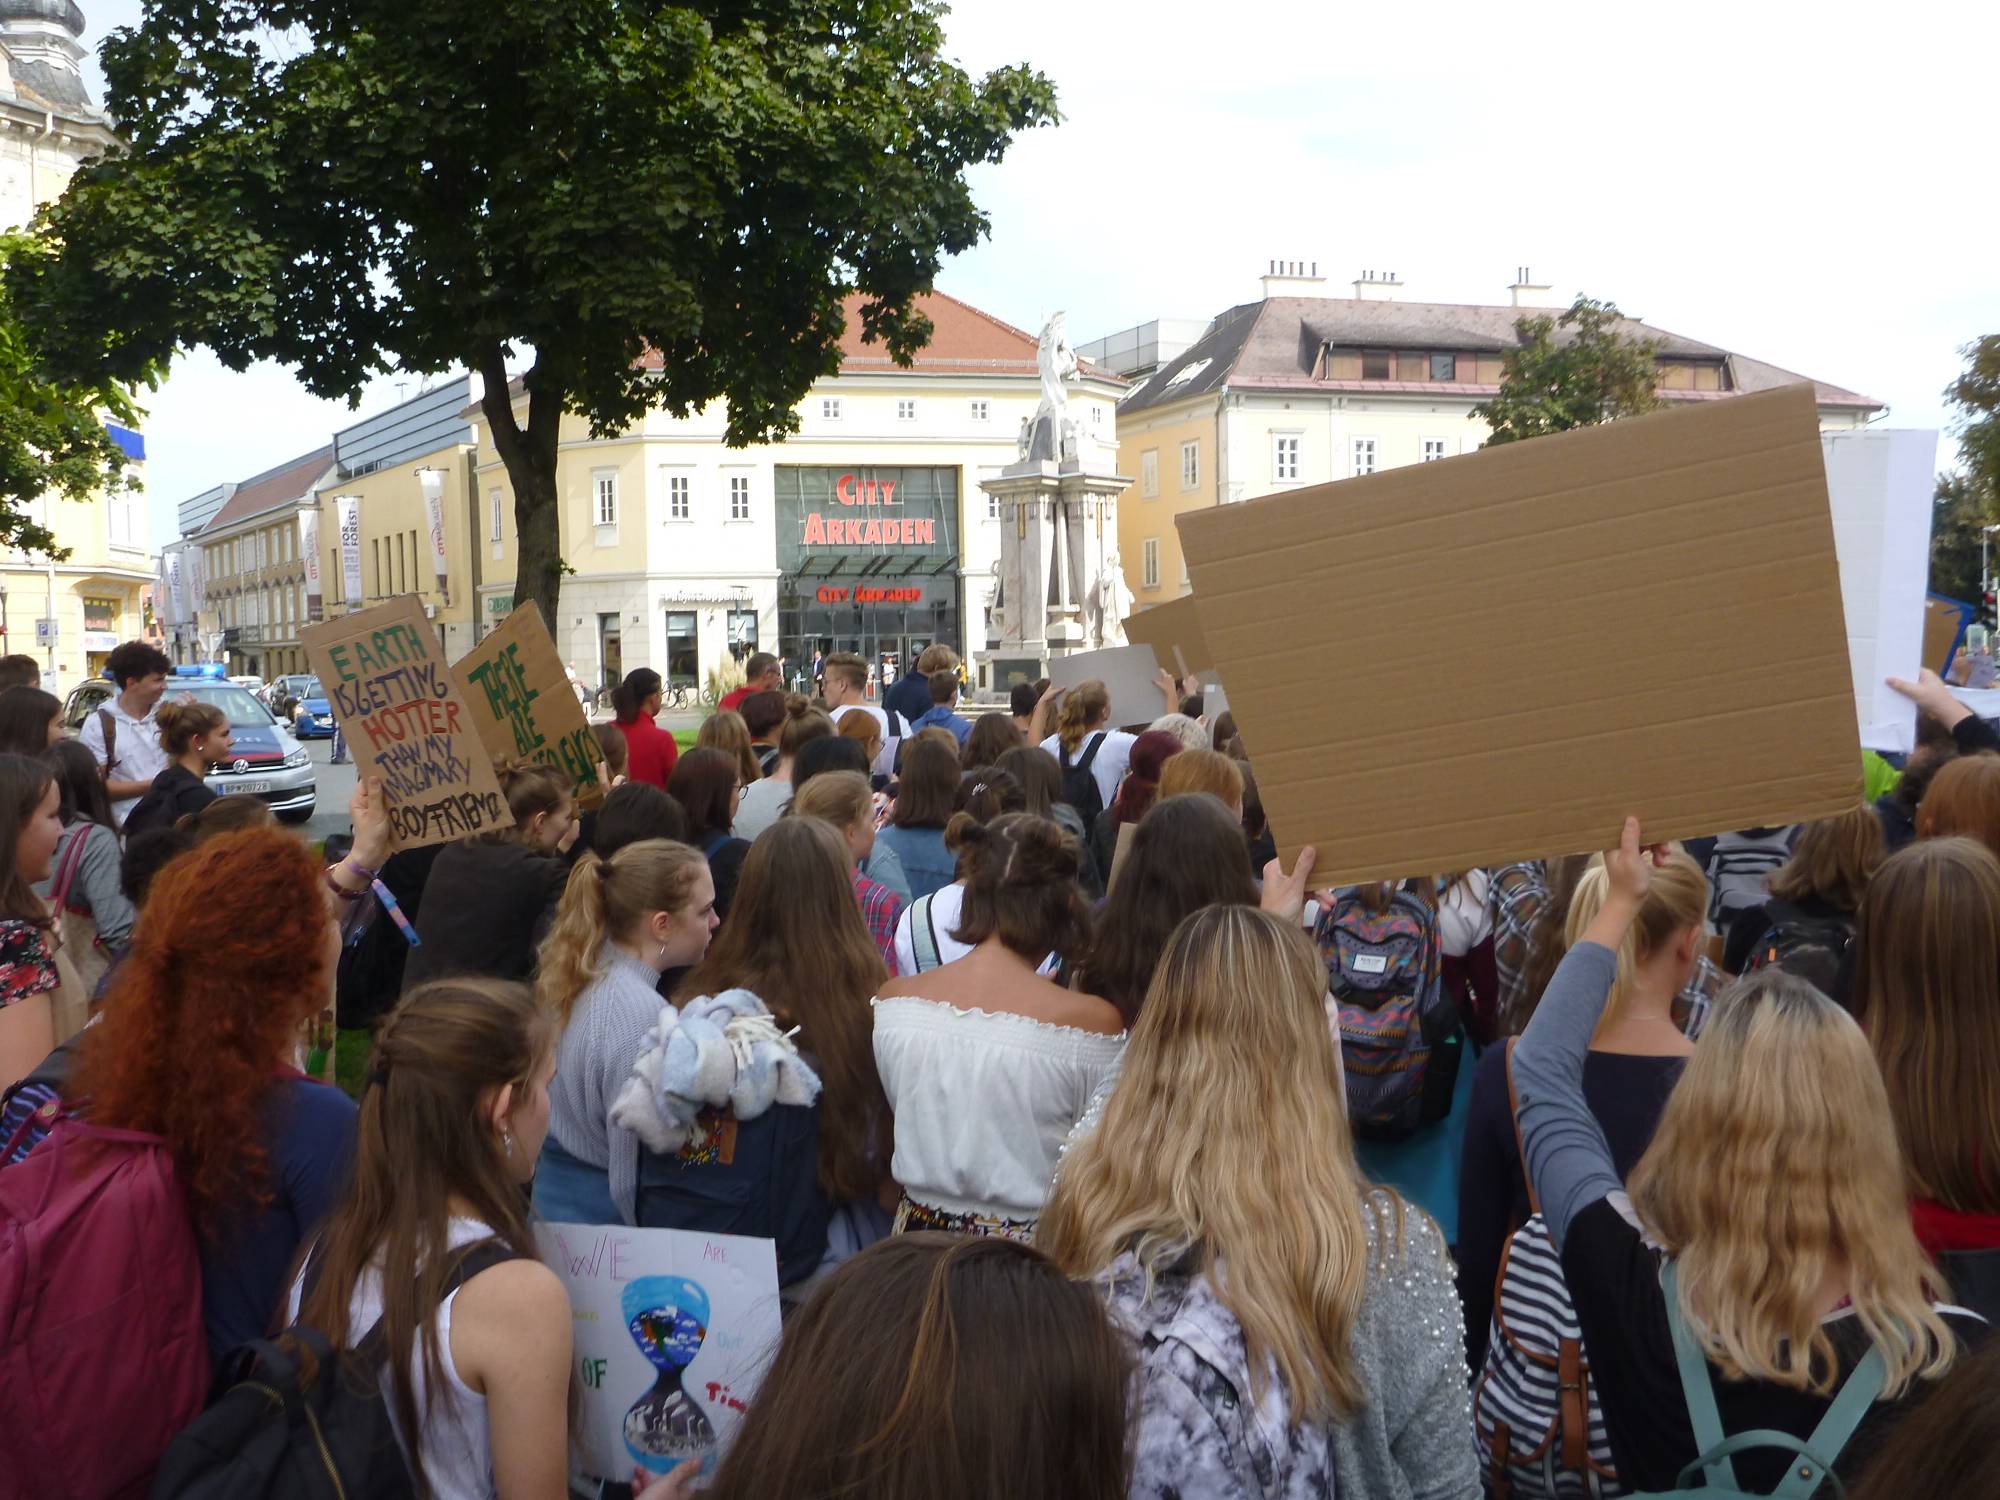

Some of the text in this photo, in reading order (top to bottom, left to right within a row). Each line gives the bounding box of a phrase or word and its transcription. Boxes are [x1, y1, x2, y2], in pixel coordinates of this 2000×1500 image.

[836, 473, 895, 506] CITY
[342, 526, 350, 546] FOR
[349, 510, 359, 546] FOREST
[803, 512, 933, 545] ARKADEN
[329, 624, 428, 681] EARTH
[467, 642, 540, 720] THERE
[361, 698, 462, 750] HOTTER
[425, 734, 452, 760] MY
[389, 791, 501, 840] BOYFRIEND
[555, 1231, 728, 1282] WE ARE
[581, 1358, 748, 1414] OF Tim
